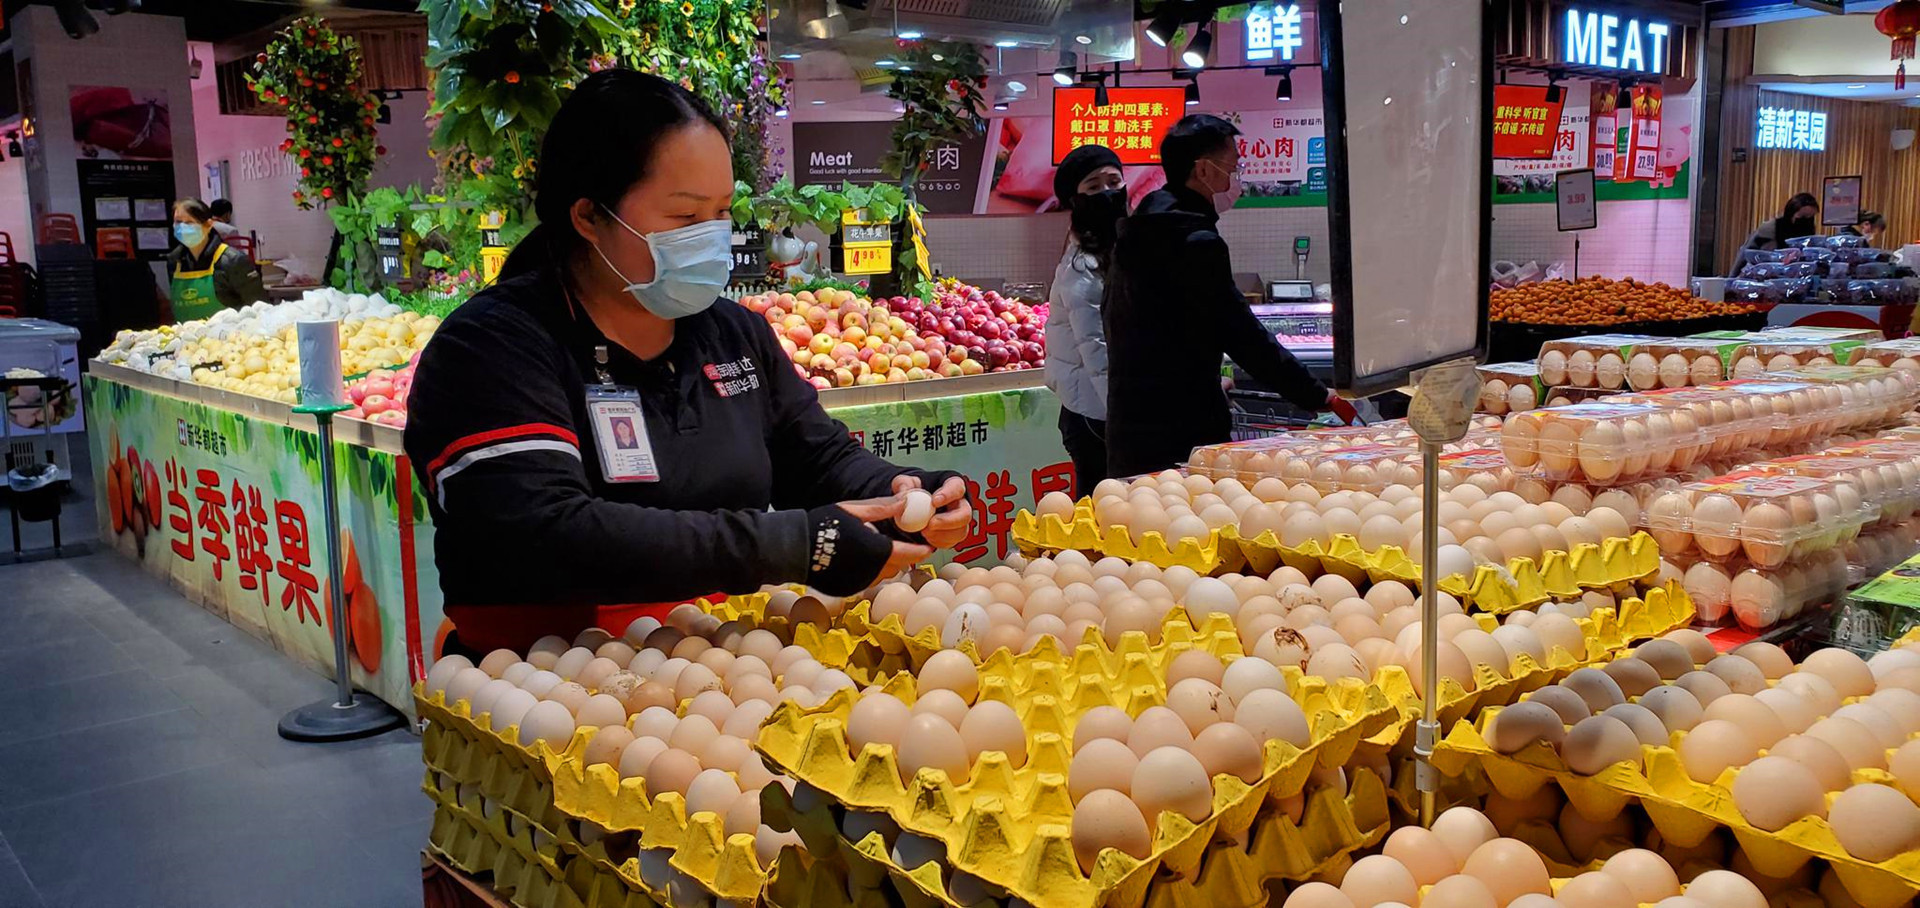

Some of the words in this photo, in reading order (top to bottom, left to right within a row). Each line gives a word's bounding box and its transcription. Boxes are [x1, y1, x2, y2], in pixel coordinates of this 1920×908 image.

[1246, 4, 1302, 60] 鲜
[1567, 9, 1668, 73] MEAT
[1070, 119, 1109, 133] 戴口罩
[1113, 119, 1153, 133] 勤洗手
[1113, 136, 1152, 149] 少聚集
[1757, 106, 1827, 151] 清新果园
[240, 146, 281, 180] FRESH
[810, 151, 853, 166] Meat
[187, 423, 228, 457] 新华都超市
[871, 418, 989, 458] 新华都超市
[165, 455, 322, 627] 当季鲜果
